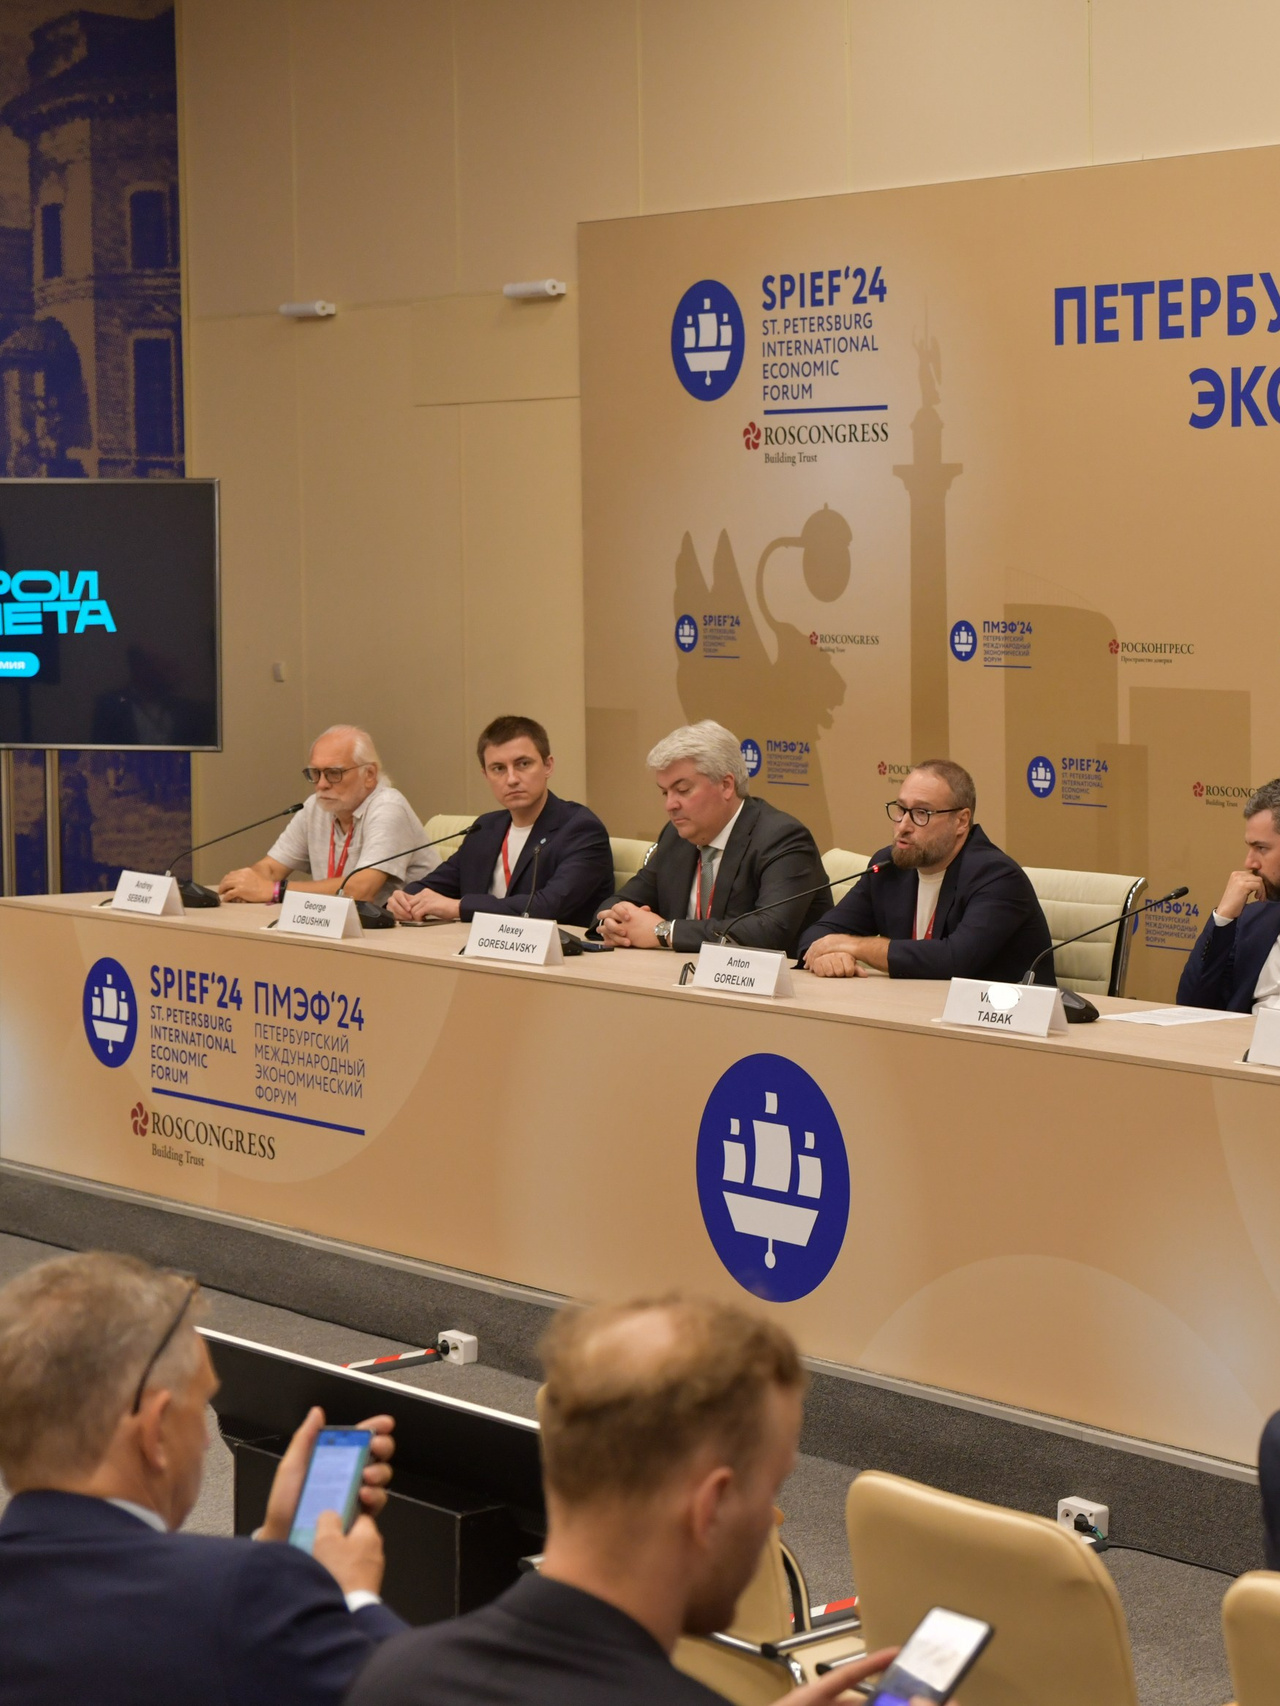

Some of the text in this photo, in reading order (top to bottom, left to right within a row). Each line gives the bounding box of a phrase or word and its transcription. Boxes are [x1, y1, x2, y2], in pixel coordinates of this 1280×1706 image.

[762, 265, 887, 311] SPIEF‘24
[762, 312, 873, 336] ST. PETERSBURG
[762, 335, 878, 358] INTERNATIONAL
[763, 359, 840, 380] ECONOMIC
[763, 383, 813, 401] FORUM
[764, 422, 889, 446] ROSCONGRESS
[764, 452, 818, 467] Building Trust
[0, 570, 98, 602] ОИ
[0, 600, 117, 636] ЕТА
[820, 634, 880, 646] ROSCONGRESS
[1121, 642, 1195, 655] РОСКОНГРЕСС
[304, 900, 327, 913] George
[292, 914, 331, 927] LOBUSHKIN
[498, 924, 524, 937] Alexey
[478, 937, 537, 953] GORESLAVSKY
[726, 956, 750, 969] Anton
[150, 964, 243, 1011] SPIEF‘24
[713, 972, 756, 987] GORELKIN
[254, 981, 364, 1031] ПМЭФ‘24
[977, 1010, 1013, 1025] TABAK
[150, 1004, 232, 1033] ST. PETERSBURG
[151, 1024, 237, 1054] INTERNATIONAL
[255, 1022, 349, 1054] ПЕТЕРБУРГСКИЙ
[151, 1044, 208, 1069] ECONOMIC
[255, 1043, 365, 1078] МЕЖДУНАРОДНЫЙ
[151, 1064, 188, 1085] FORUM
[255, 1063, 363, 1099] ЭКОНОМИЧЕСКИЙ
[255, 1084, 297, 1107] ФОРУМ
[151, 1112, 276, 1160] ROSCONGRESS
[152, 1143, 205, 1167] Building Trust
